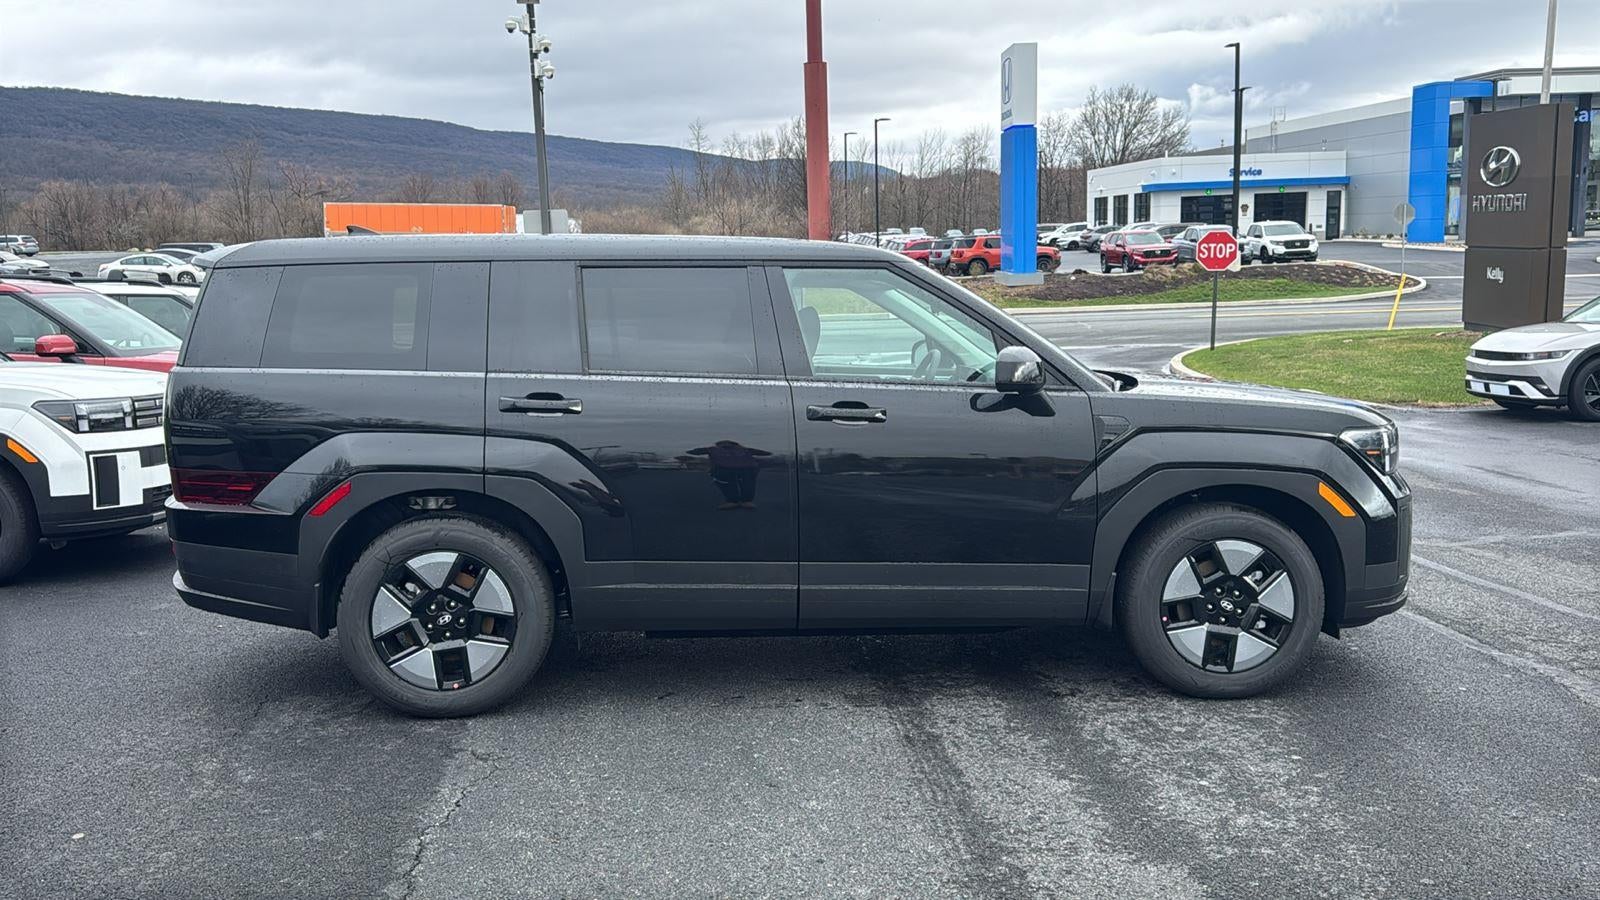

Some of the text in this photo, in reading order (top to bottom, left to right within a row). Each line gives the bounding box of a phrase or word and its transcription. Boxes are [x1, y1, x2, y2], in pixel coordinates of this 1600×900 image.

[1229, 167, 1262, 177] Srvice
[1472, 193, 1527, 212] HYUNDAI
[1199, 243, 1235, 259] STOP
[1486, 266, 1504, 284] Kelly
